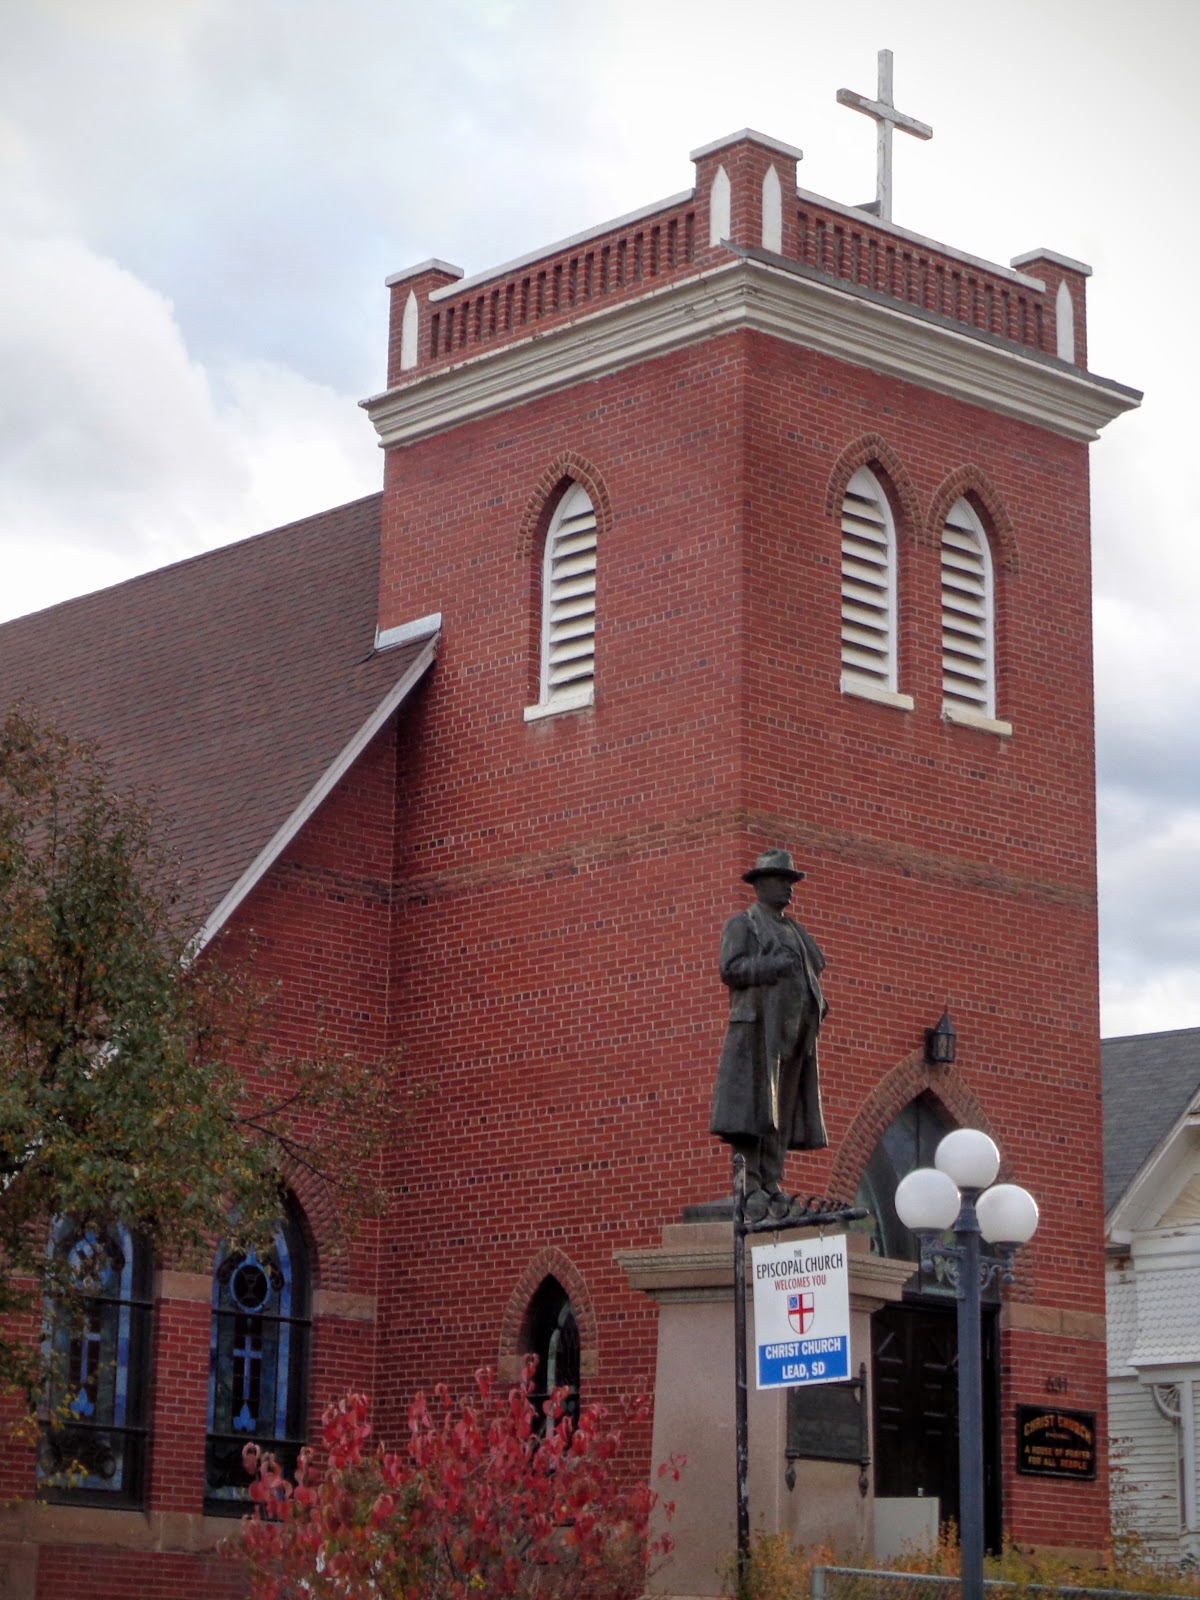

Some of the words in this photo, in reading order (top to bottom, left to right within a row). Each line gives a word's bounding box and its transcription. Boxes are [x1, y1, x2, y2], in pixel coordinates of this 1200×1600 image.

[794, 1249, 802, 1258] THE
[756, 1258, 804, 1279] EPISCOPAL
[805, 1253, 843, 1272] CHURCH
[774, 1276, 811, 1292] WELCOMES
[812, 1274, 826, 1286] YOU
[765, 1343, 800, 1360] CHRIST
[801, 1337, 841, 1356] CHURCH
[782, 1363, 809, 1380] LEAD,
[811, 1361, 825, 1376] SD
[1023, 1414, 1055, 1436] CHRIST
[1057, 1414, 1092, 1445] CHURCH
[1024, 1444, 1031, 1453] A
[1028, 1455, 1041, 1465] FOR
[1043, 1457, 1057, 1467] ALL
